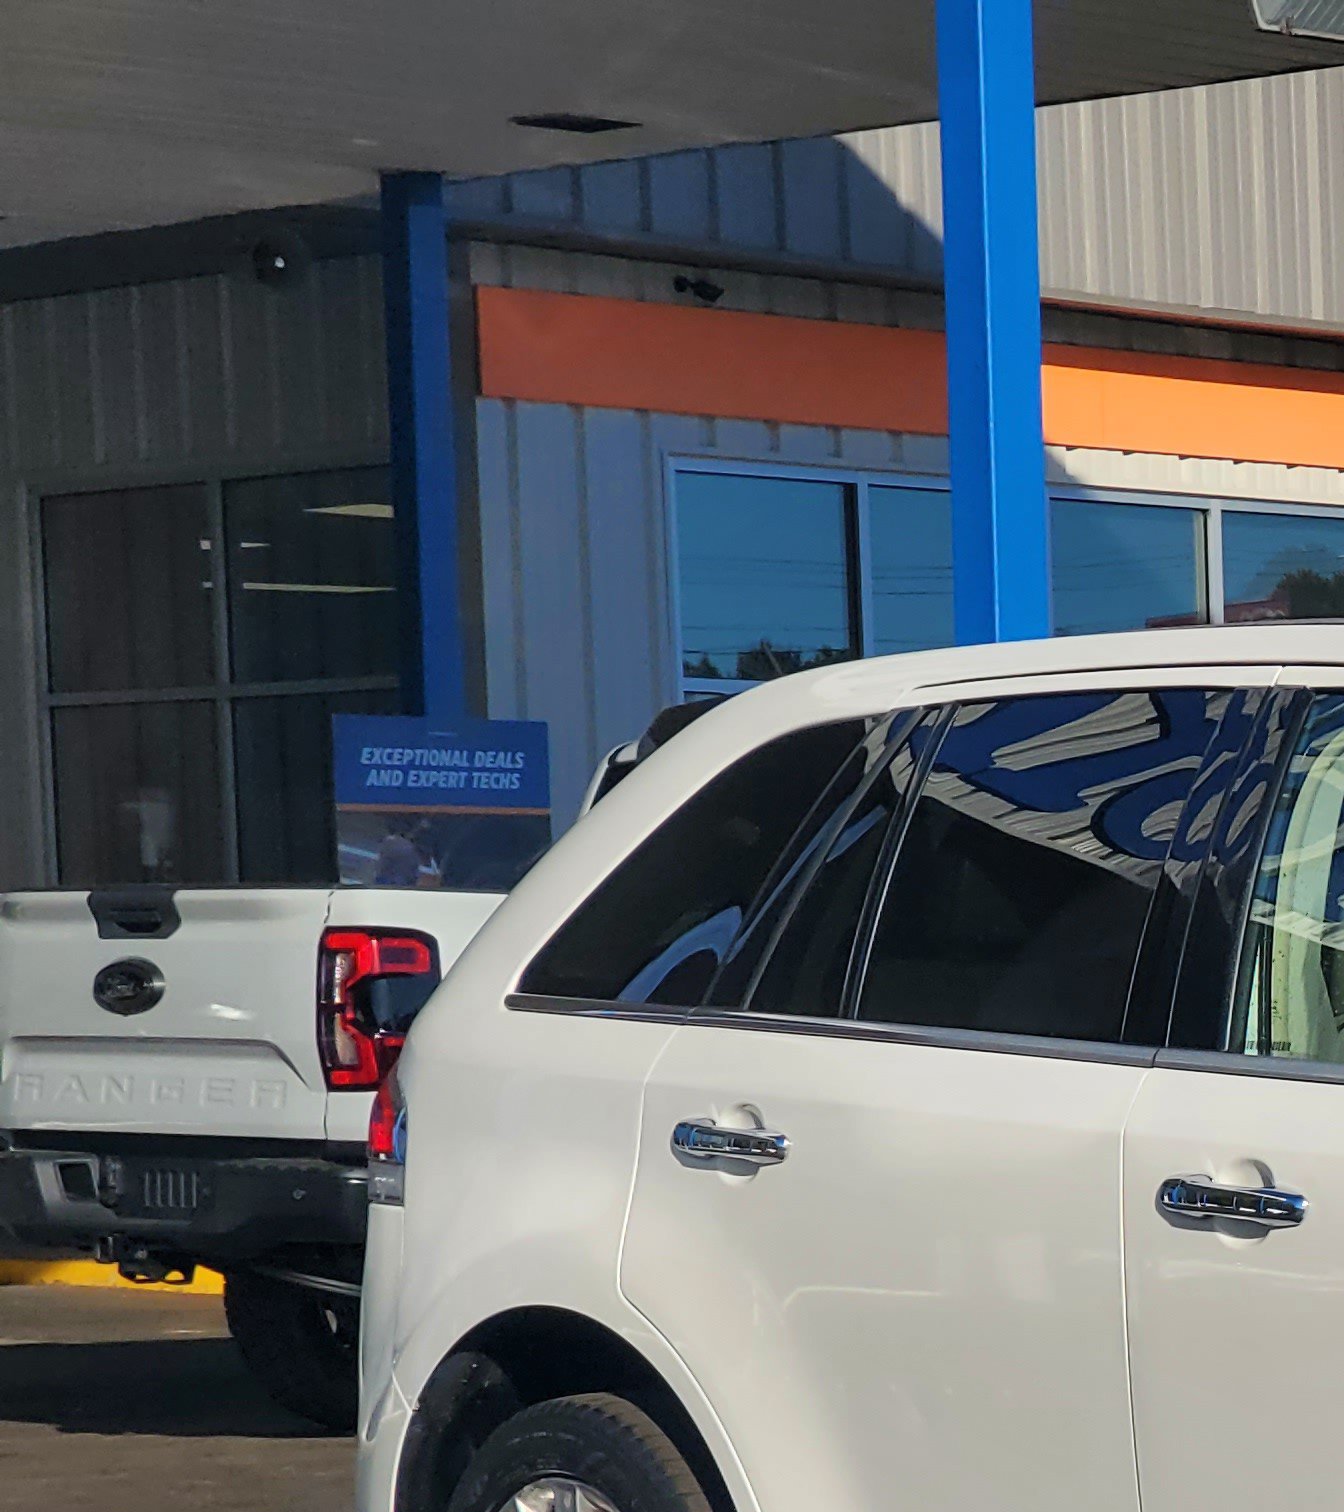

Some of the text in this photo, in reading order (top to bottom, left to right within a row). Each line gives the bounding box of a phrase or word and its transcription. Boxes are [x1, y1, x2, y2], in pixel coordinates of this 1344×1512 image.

[360, 747, 526, 769] EXCEPTIONAL DEALS
[366, 769, 522, 790] AND EXPERT TECHS
[14, 1072, 288, 1108] RANGER
